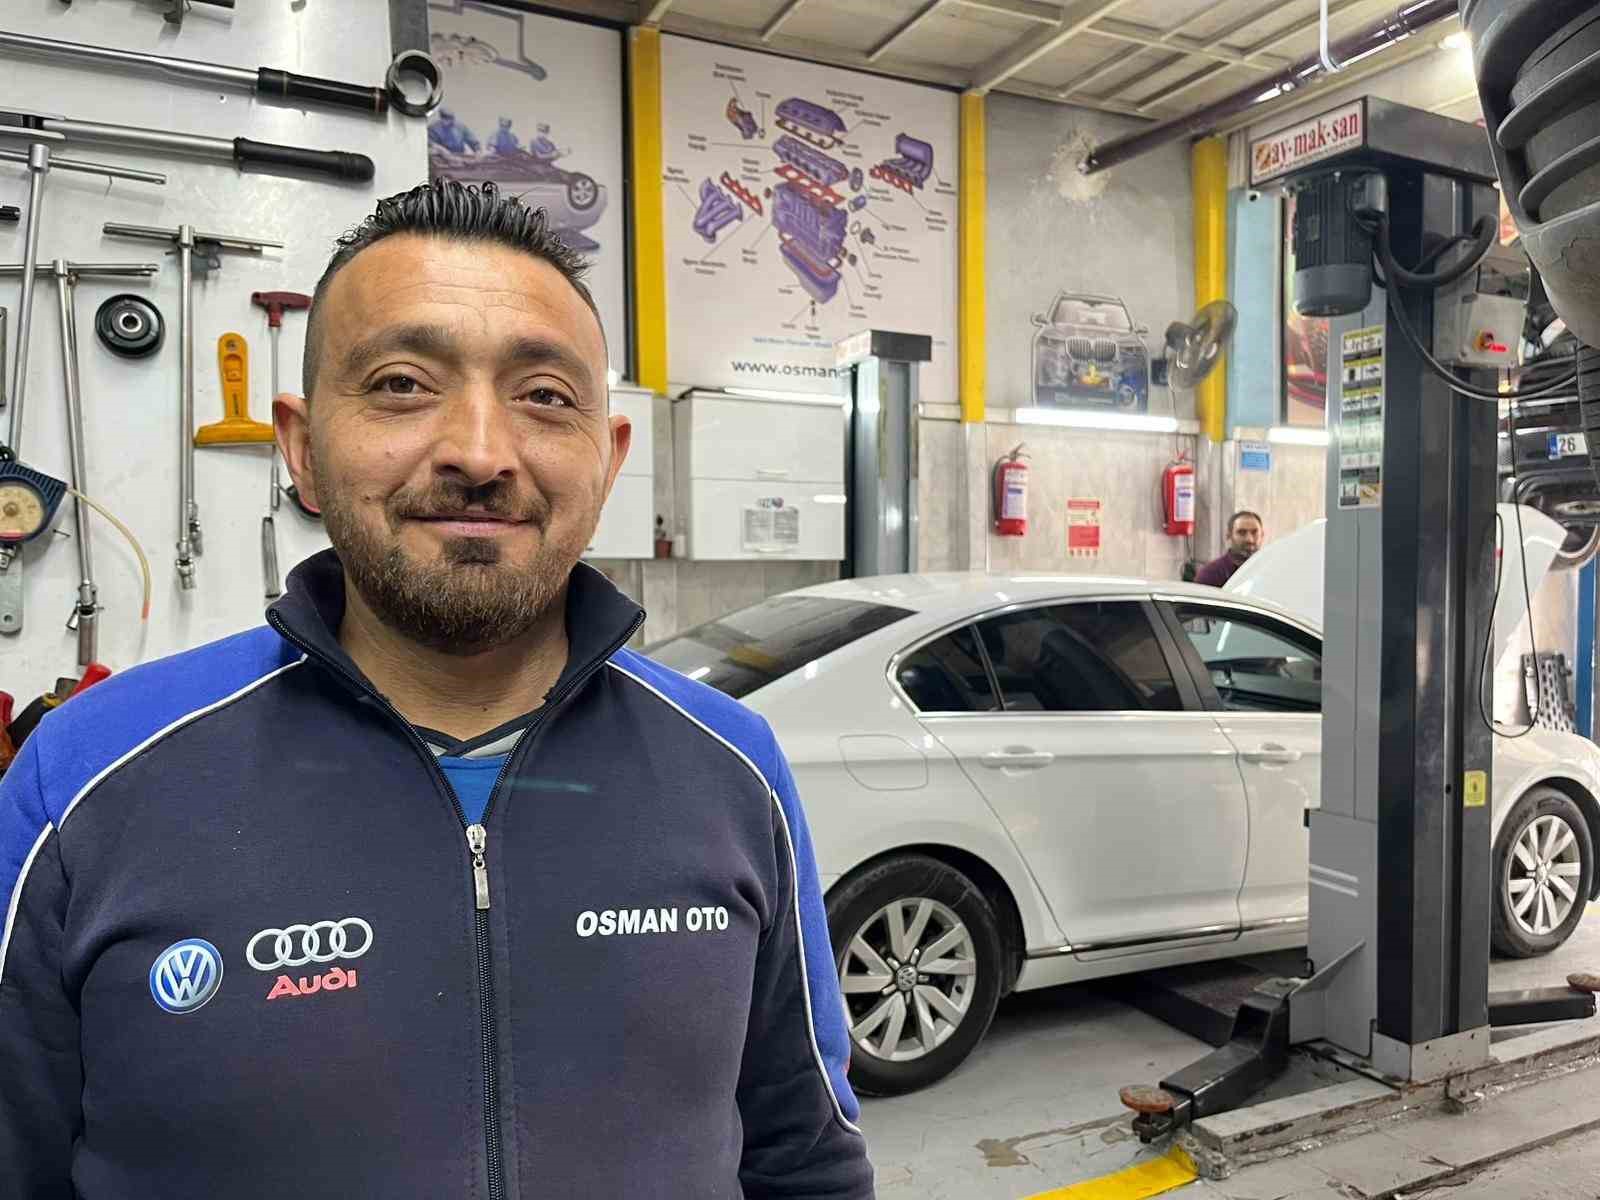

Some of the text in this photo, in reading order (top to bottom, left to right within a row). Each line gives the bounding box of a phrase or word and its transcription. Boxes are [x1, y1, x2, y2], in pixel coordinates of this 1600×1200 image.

[731, 361, 840, 378] www.osman
[576, 906, 729, 937] OSMAN OTO
[266, 967, 358, 1000] Audi
